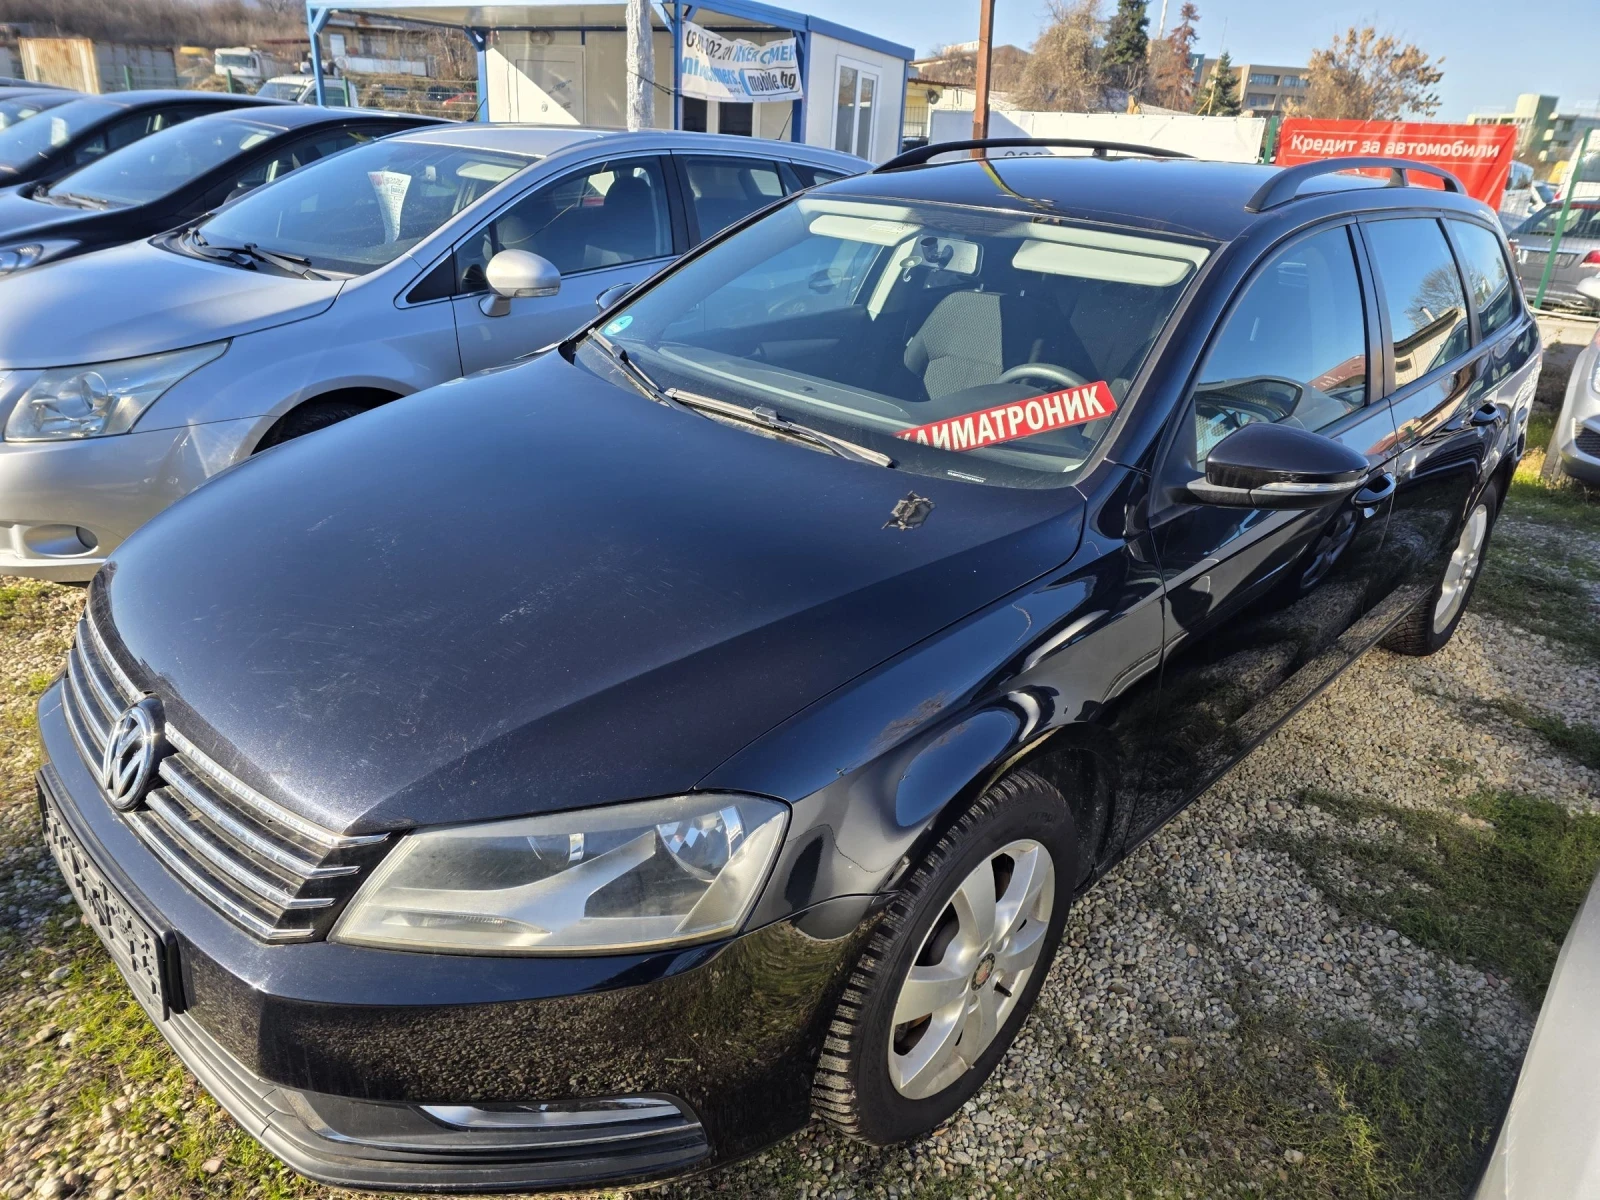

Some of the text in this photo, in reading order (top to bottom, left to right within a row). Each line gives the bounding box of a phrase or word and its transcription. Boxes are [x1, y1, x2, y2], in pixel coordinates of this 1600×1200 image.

[747, 71, 797, 92] mobile.bg
[1291, 134, 1499, 158] Кредит за автомобили
